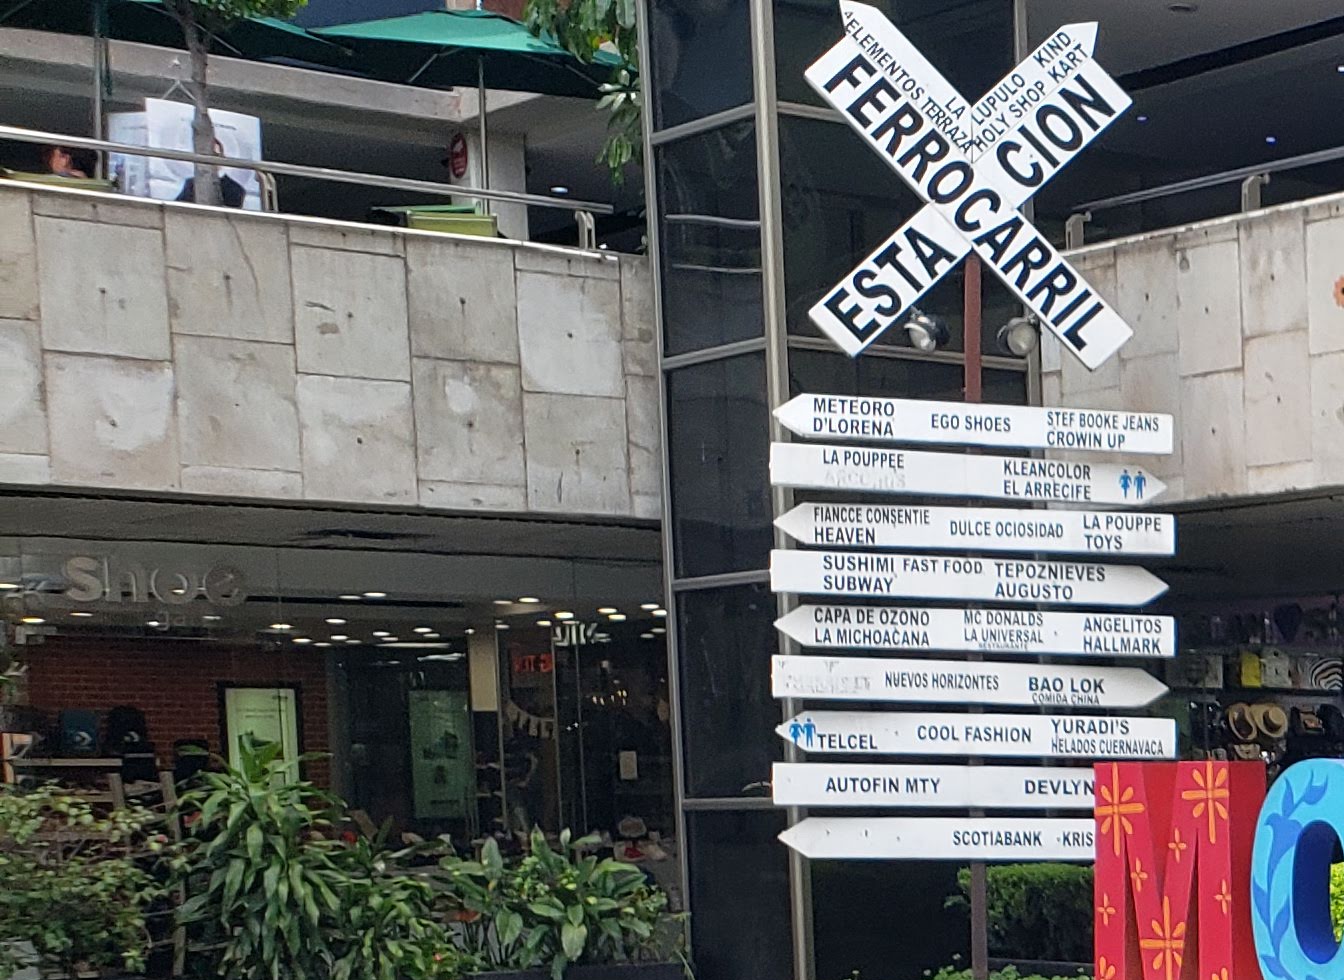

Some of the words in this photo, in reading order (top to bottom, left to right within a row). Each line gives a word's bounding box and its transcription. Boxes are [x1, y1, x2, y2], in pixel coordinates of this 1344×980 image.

[845, 18, 925, 100] ELEMENTOS
[921, 97, 975, 154] TERRAZA
[972, 72, 1026, 126] LUPULO
[1032, 31, 1072, 68] KIND
[973, 116, 1011, 152] HOLY
[1013, 81, 1047, 118] SHOP
[1047, 44, 1088, 83] KART
[945, 97, 965, 120] LA
[823, 53, 1104, 352] FERROCARRIL
[824, 226, 958, 344] ESTA
[995, 74, 1118, 188] CION
[813, 397, 895, 417] METEORO
[813, 417, 894, 437] D'LORENA
[931, 413, 959, 430] EGO
[964, 414, 1011, 432] SHOES
[1047, 411, 1075, 427] STEF
[1079, 413, 1118, 430] BOOKE
[1122, 415, 1159, 432] JEANS
[1047, 431, 1102, 447] CROWIN
[1107, 434, 1126, 449] UP
[823, 449, 839, 465] LA
[844, 450, 904, 469] POUPPEE
[1003, 459, 1091, 480] KLEANCOLOR
[1003, 480, 1020, 496] EL
[1024, 481, 1091, 500] ARRECIFE
[814, 506, 862, 523] FIANCCE
[866, 508, 930, 525] CONSENTIE
[1083, 514, 1101, 530] LA
[1106, 515, 1161, 532] POUPPE
[814, 526, 876, 544] HEAVEN
[950, 520, 991, 536] DULCE
[995, 522, 1064, 538] OCIOSIDAD
[1084, 534, 1123, 550] TOYS
[823, 555, 894, 573] SUSHIMI
[903, 558, 939, 573] FAST
[944, 559, 983, 574] FOOD
[994, 562, 1106, 582] TEPOZNIEVES
[823, 575, 894, 593] SUBWAY
[995, 583, 1073, 600] AUGUSTO
[814, 607, 852, 624] CAPA
[856, 608, 875, 624] DE
[879, 609, 930, 626] OZONO
[963, 609, 982, 624] MC
[986, 611, 1044, 627] DONALDS
[1083, 617, 1162, 634] ANGELITOS
[814, 627, 832, 644] LA
[836, 628, 930, 647] MICHOACANA
[963, 627, 978, 642] LA
[981, 628, 1044, 644] UNIVERSAL
[1083, 636, 1162, 654] HALLMARK
[885, 671, 928, 688] NUEVOS
[931, 673, 999, 690] HORIZONTES
[1028, 676, 1064, 692] BAO
[1070, 678, 1105, 694] LOK
[1032, 692, 1068, 704] COMIDA
[1071, 694, 1100, 705] CHINA
[917, 725, 959, 741] COOL
[965, 726, 1032, 742] FASHION
[1051, 719, 1130, 735] YURADI'S
[816, 734, 878, 750] TELCEL
[1051, 737, 1096, 754] HELADOS
[1099, 739, 1164, 756] CUERNAVACA
[825, 777, 899, 793] AUTOFIN
[905, 777, 941, 794] MTY
[1024, 779, 1095, 795] DEVLYN
[953, 830, 1042, 847] SCOTIABANK
